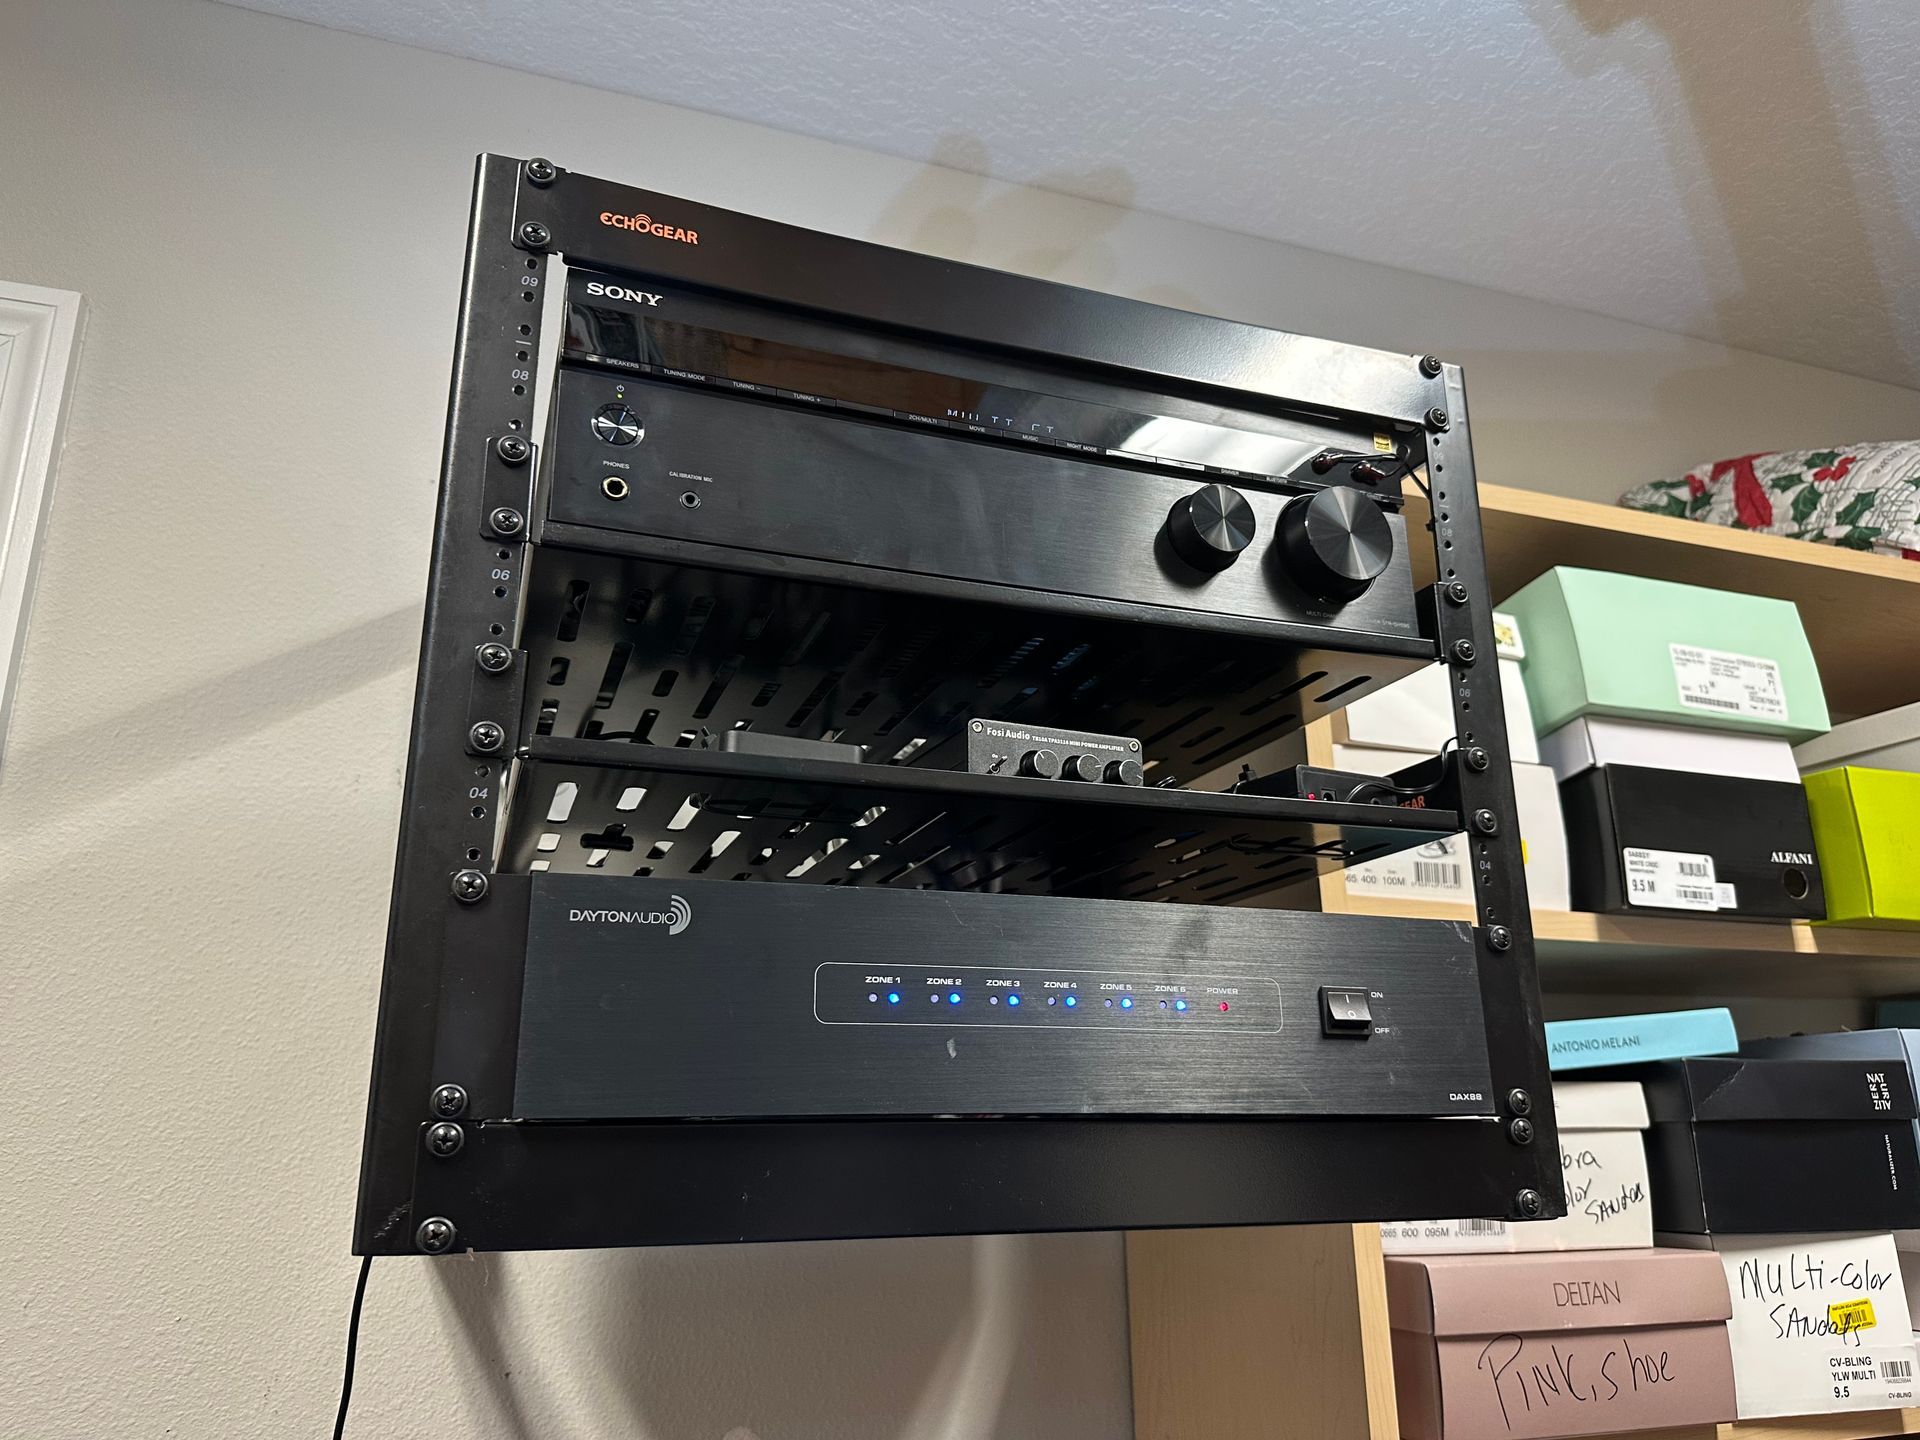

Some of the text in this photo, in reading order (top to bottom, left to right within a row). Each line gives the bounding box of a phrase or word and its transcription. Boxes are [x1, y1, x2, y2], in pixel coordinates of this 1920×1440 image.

[600, 211, 699, 245] ECHOGEAR
[521, 275, 539, 287] 09
[586, 282, 663, 306] SONY
[606, 358, 639, 369] SPEAKERS
[511, 369, 529, 380] 08
[663, 368, 706, 381] TUNING MODE
[733, 381, 755, 391] TUNING
[793, 392, 815, 402] TUNING
[968, 425, 986, 433] MOVIE
[1022, 434, 1039, 442] MUSIC
[1082, 445, 1098, 453] MODE
[602, 460, 630, 469] PHONES
[491, 568, 510, 581] 06
[986, 727, 1004, 737] Fosi
[1005, 730, 1030, 740] Audio
[1081, 741, 1099, 749] POWER
[1099, 744, 1124, 752] AMPLIFIER
[469, 787, 488, 799] 04
[1770, 851, 1813, 865] ALFANI
[1480, 860, 1491, 870] 04
[1360, 875, 1377, 884] 400
[1382, 876, 1405, 886] 100M
[1632, 879, 1656, 892] 9.5 M
[865, 976, 893, 984] ZONE
[926, 977, 954, 985] ZONE
[986, 979, 1013, 987] ZONE
[1043, 981, 1070, 989] ZONE
[1100, 983, 1125, 991] ZONE
[1154, 985, 1179, 993] ZONE
[1206, 987, 1239, 995] POWER
[1370, 991, 1384, 999] ON
[1551, 1035, 1641, 1053] ANTONIO MELANI
[1449, 1093, 1482, 1101] DAX88
[1560, 1143, 1602, 1169] bra
[1401, 1227, 1418, 1237] 600
[1425, 1227, 1449, 1237] 095M
[1553, 1280, 1621, 1307] DELTAN
[1829, 1356, 1872, 1367] CV-BLING
[1831, 1371, 1850, 1381] YLW
[1851, 1370, 1876, 1381] MULTI
[1833, 1386, 1850, 1398] 9.5
[1888, 1391, 1912, 1399] CV-BLING
